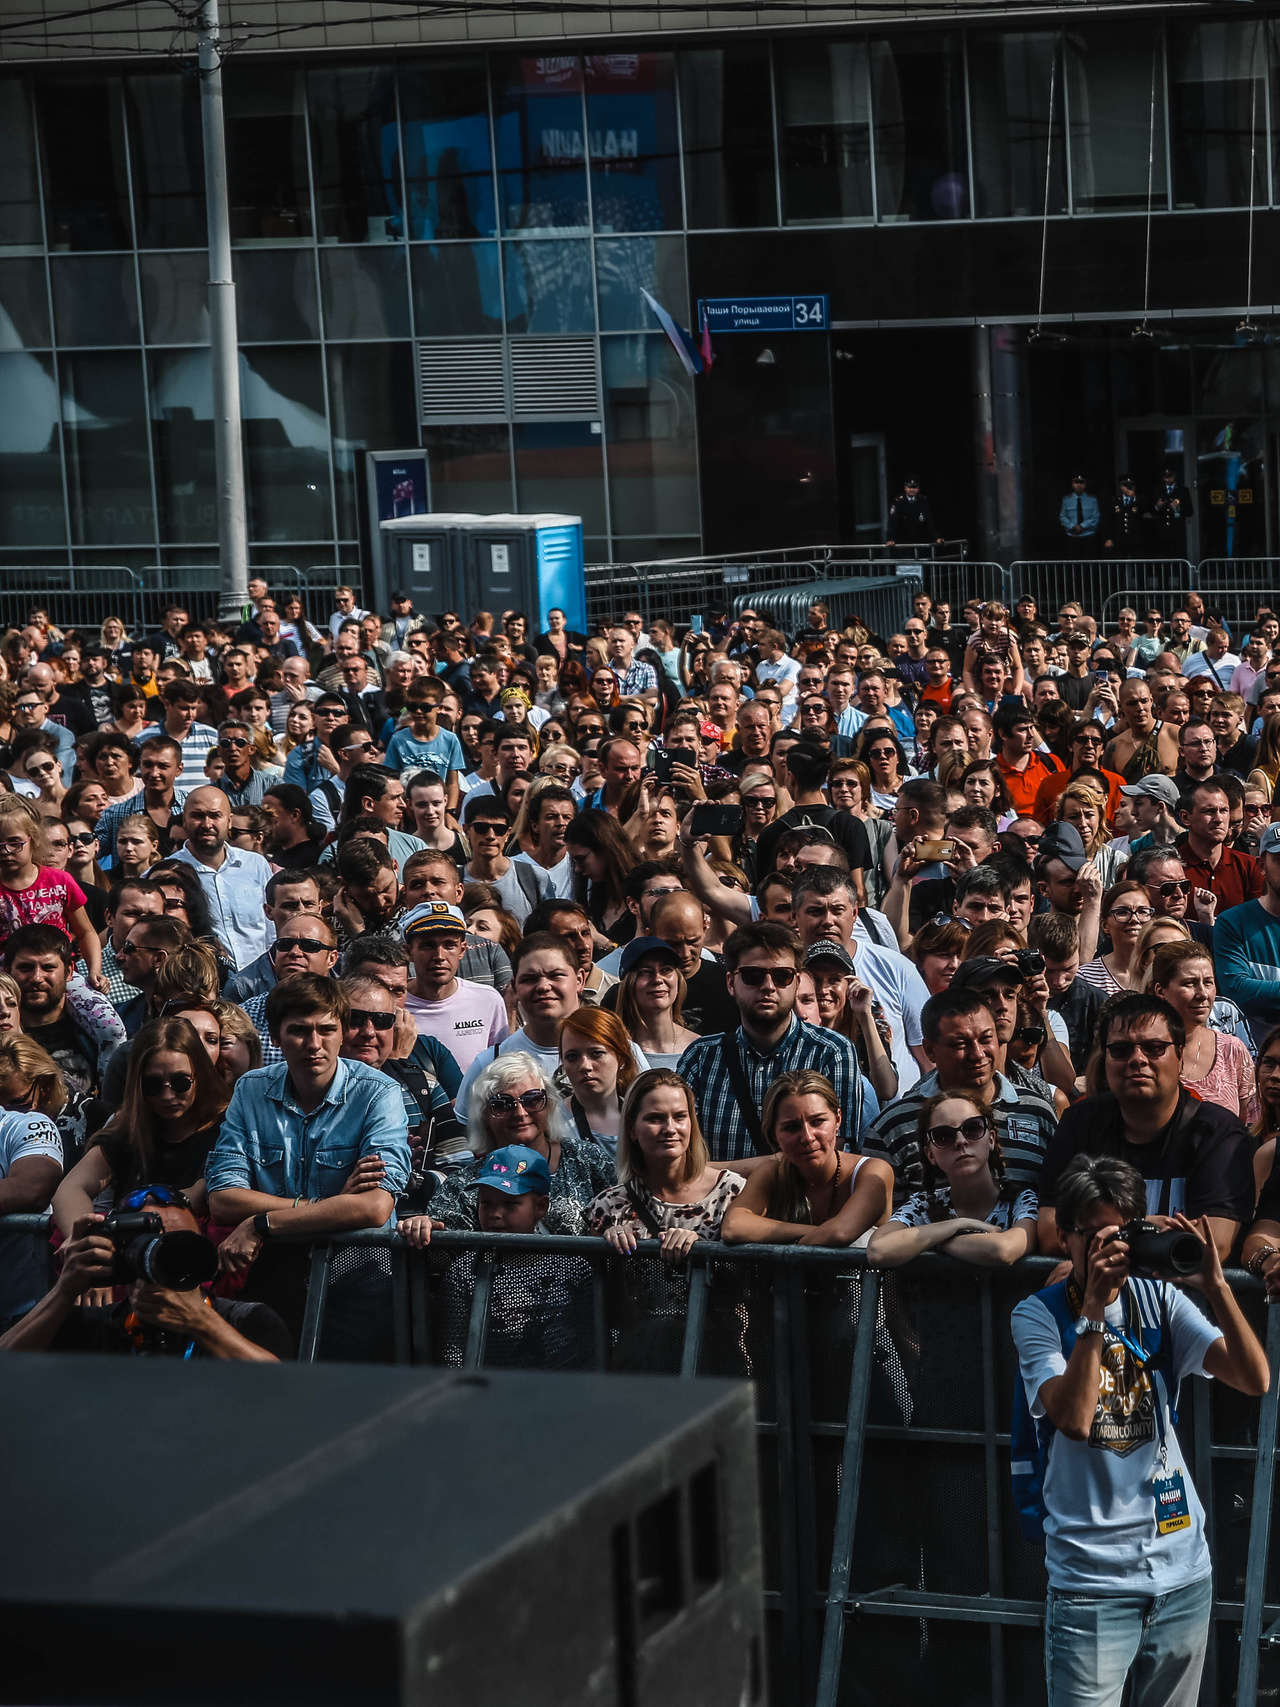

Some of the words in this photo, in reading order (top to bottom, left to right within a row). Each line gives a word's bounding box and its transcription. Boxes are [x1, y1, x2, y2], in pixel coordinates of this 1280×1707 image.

[731, 302, 791, 315] Порываевой
[795, 302, 822, 323] 34
[733, 316, 760, 327] улица
[454, 1019, 484, 1029] KINGS
[1118, 1421, 1152, 1439] COUNTY
[1160, 1489, 1182, 1502] НАШИ
[1165, 1519, 1183, 1528] ПРЕССА
